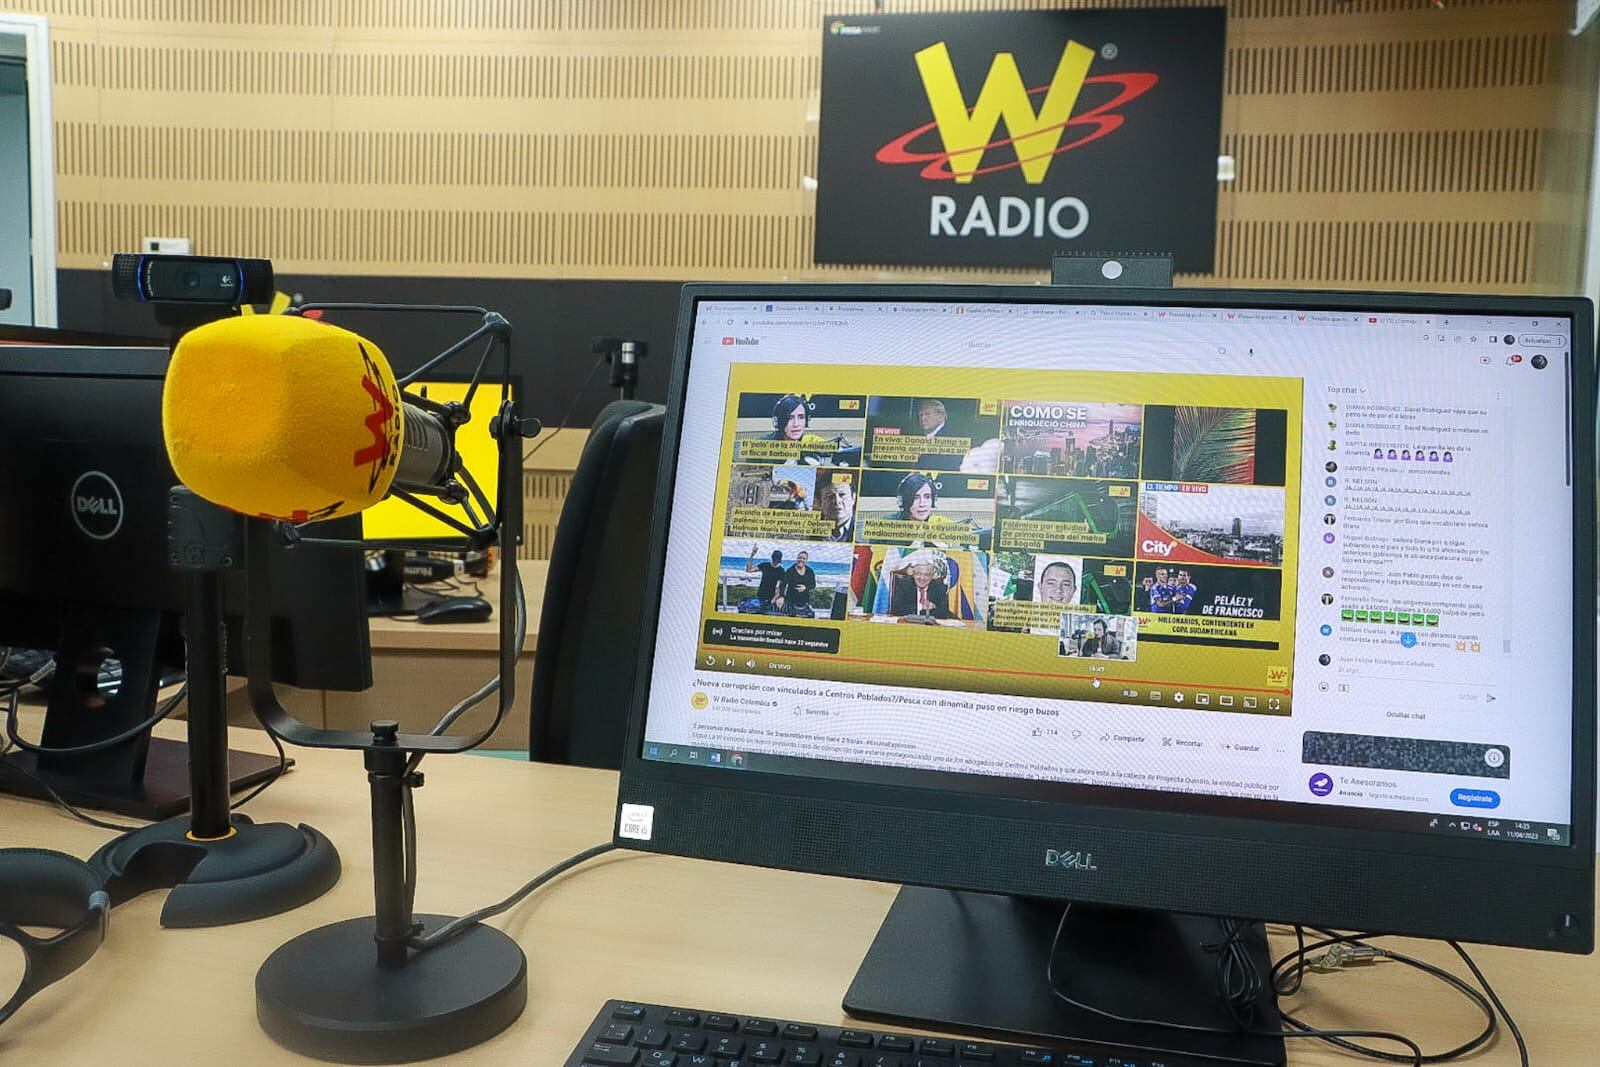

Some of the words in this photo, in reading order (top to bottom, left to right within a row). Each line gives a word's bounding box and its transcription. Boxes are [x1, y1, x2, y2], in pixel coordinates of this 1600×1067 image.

[914, 40, 1096, 184] W
[930, 195, 1090, 239] RADIO
[735, 337, 759, 346] YouTube
[1327, 386, 1340, 394] Top
[1066, 407, 1088, 420] SE
[1060, 421, 1087, 429] CHINA
[934, 438, 958, 446] Trump
[769, 450, 798, 458] Barbosa
[1155, 483, 1179, 491] TIEMPO
[1192, 485, 1207, 493] VIVO
[77, 496, 118, 515] DELL
[864, 520, 914, 530] MinAmbiente
[939, 533, 977, 541] Colombia
[1141, 539, 1172, 557] City
[1214, 594, 1245, 607] PELÁEZ
[1247, 598, 1254, 607] Y
[1202, 605, 1213, 615] DE
[1214, 606, 1264, 618] FRANCISCO
[1172, 626, 1188, 634] COPA
[1189, 627, 1238, 636] SUDAMERICANA
[692, 679, 720, 689] ¿Nueva
[721, 682, 760, 693] corrupción
[762, 685, 776, 693] con
[777, 686, 817, 697] vinculados
[825, 690, 855, 700] Centros
[939, 700, 974, 710] dinamita
[976, 704, 996, 712] puso
[1009, 706, 1034, 715] riesgo
[1035, 707, 1060, 717] buzos
[721, 696, 739, 704] Radio
[740, 697, 771, 707] Colombia
[1411, 712, 1426, 720] chat
[1339, 777, 1349, 785] Te
[1350, 777, 1397, 788] Asesoramos
[1045, 849, 1097, 870] DELL
